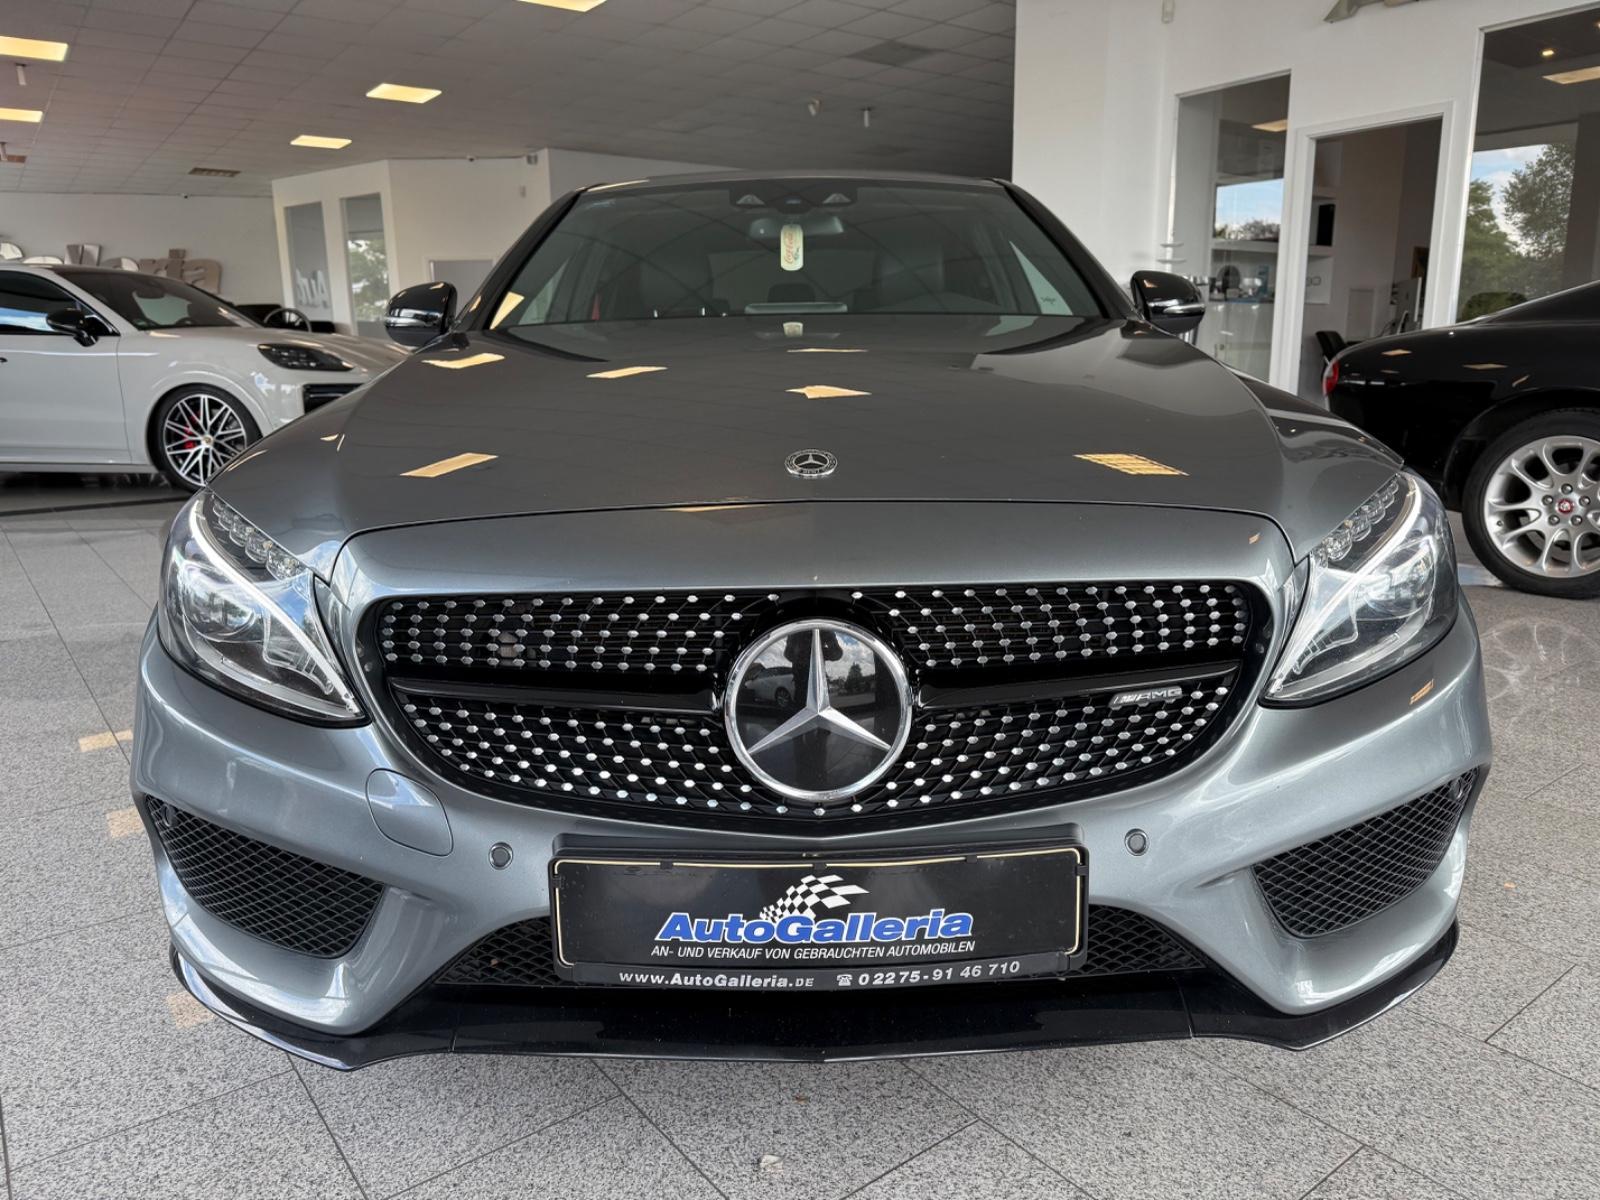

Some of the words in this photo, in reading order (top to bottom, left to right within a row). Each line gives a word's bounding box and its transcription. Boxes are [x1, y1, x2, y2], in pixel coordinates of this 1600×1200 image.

[654, 908, 974, 944] AutoGalleria
[651, 945, 674, 957] AN-
[677, 947, 704, 959] UND
[707, 947, 763, 960] VERKAUF
[764, 948, 791, 960] VON
[793, 946, 884, 960] GEBRAUCHTEN
[886, 940, 976, 957] AUTOMOBILEN
[959, 965, 982, 979] 46
[988, 960, 1021, 976] 710
